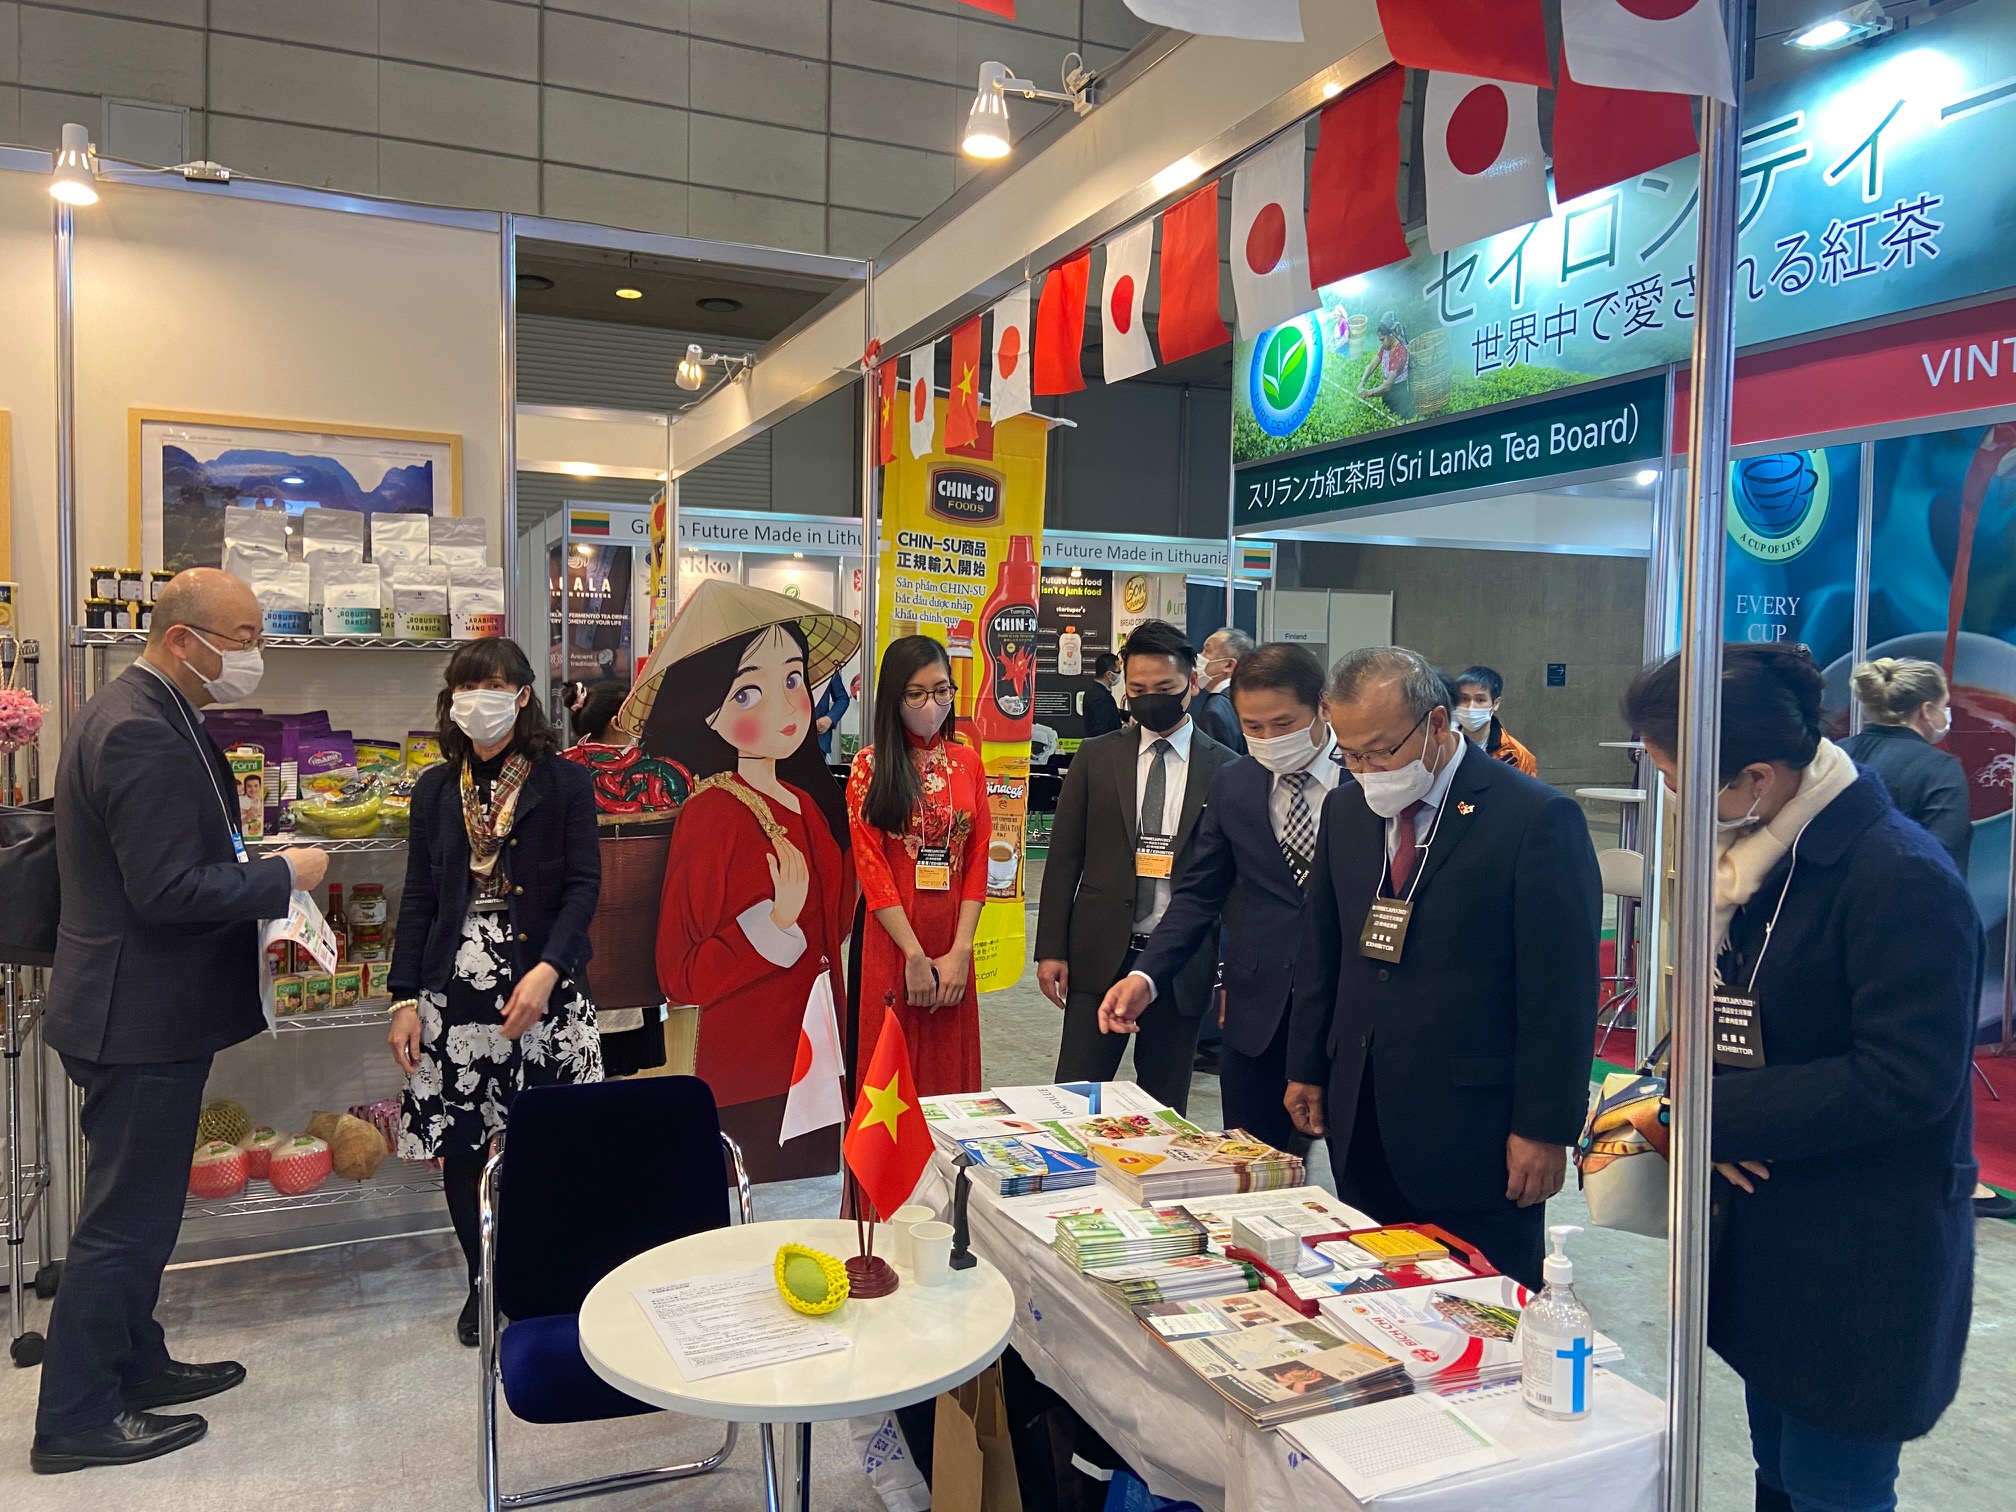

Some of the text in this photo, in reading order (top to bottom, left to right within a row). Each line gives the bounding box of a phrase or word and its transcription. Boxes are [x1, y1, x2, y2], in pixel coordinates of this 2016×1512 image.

[1271, 406, 1306, 430] CEYLON
[1305, 374, 1318, 401] TEA
[1247, 402, 1640, 511] スリランカ紅茶局 (Sri Lanka Tea Board)
[937, 480, 994, 503] CHIN-SU
[948, 500, 984, 513] FOODS
[631, 519, 862, 546] Grn Future Made in Lithu
[1740, 533, 1803, 554] A CUP OF LIFE
[1056, 542, 1228, 565] Future Made in Lithuania
[896, 551, 986, 577] 正規輸入開始
[940, 582, 986, 596] CHIN-SU
[1041, 576, 1102, 587] Future fast food
[1065, 586, 1083, 598] junk
[1083, 587, 1102, 596] food
[951, 598, 973, 613] nhập
[1736, 595, 1800, 616] EVERY
[267, 613, 301, 621] ROBUSTA
[409, 617, 441, 625] ROBUSTA
[943, 617, 960, 628] quy
[994, 617, 1036, 632] CHIN-SU
[1120, 619, 1134, 627] BREAD
[1284, 632, 1307, 640] Finland
[1747, 623, 1787, 643] CUP
[1716, 1044, 1754, 1056] EXHIBITOR
